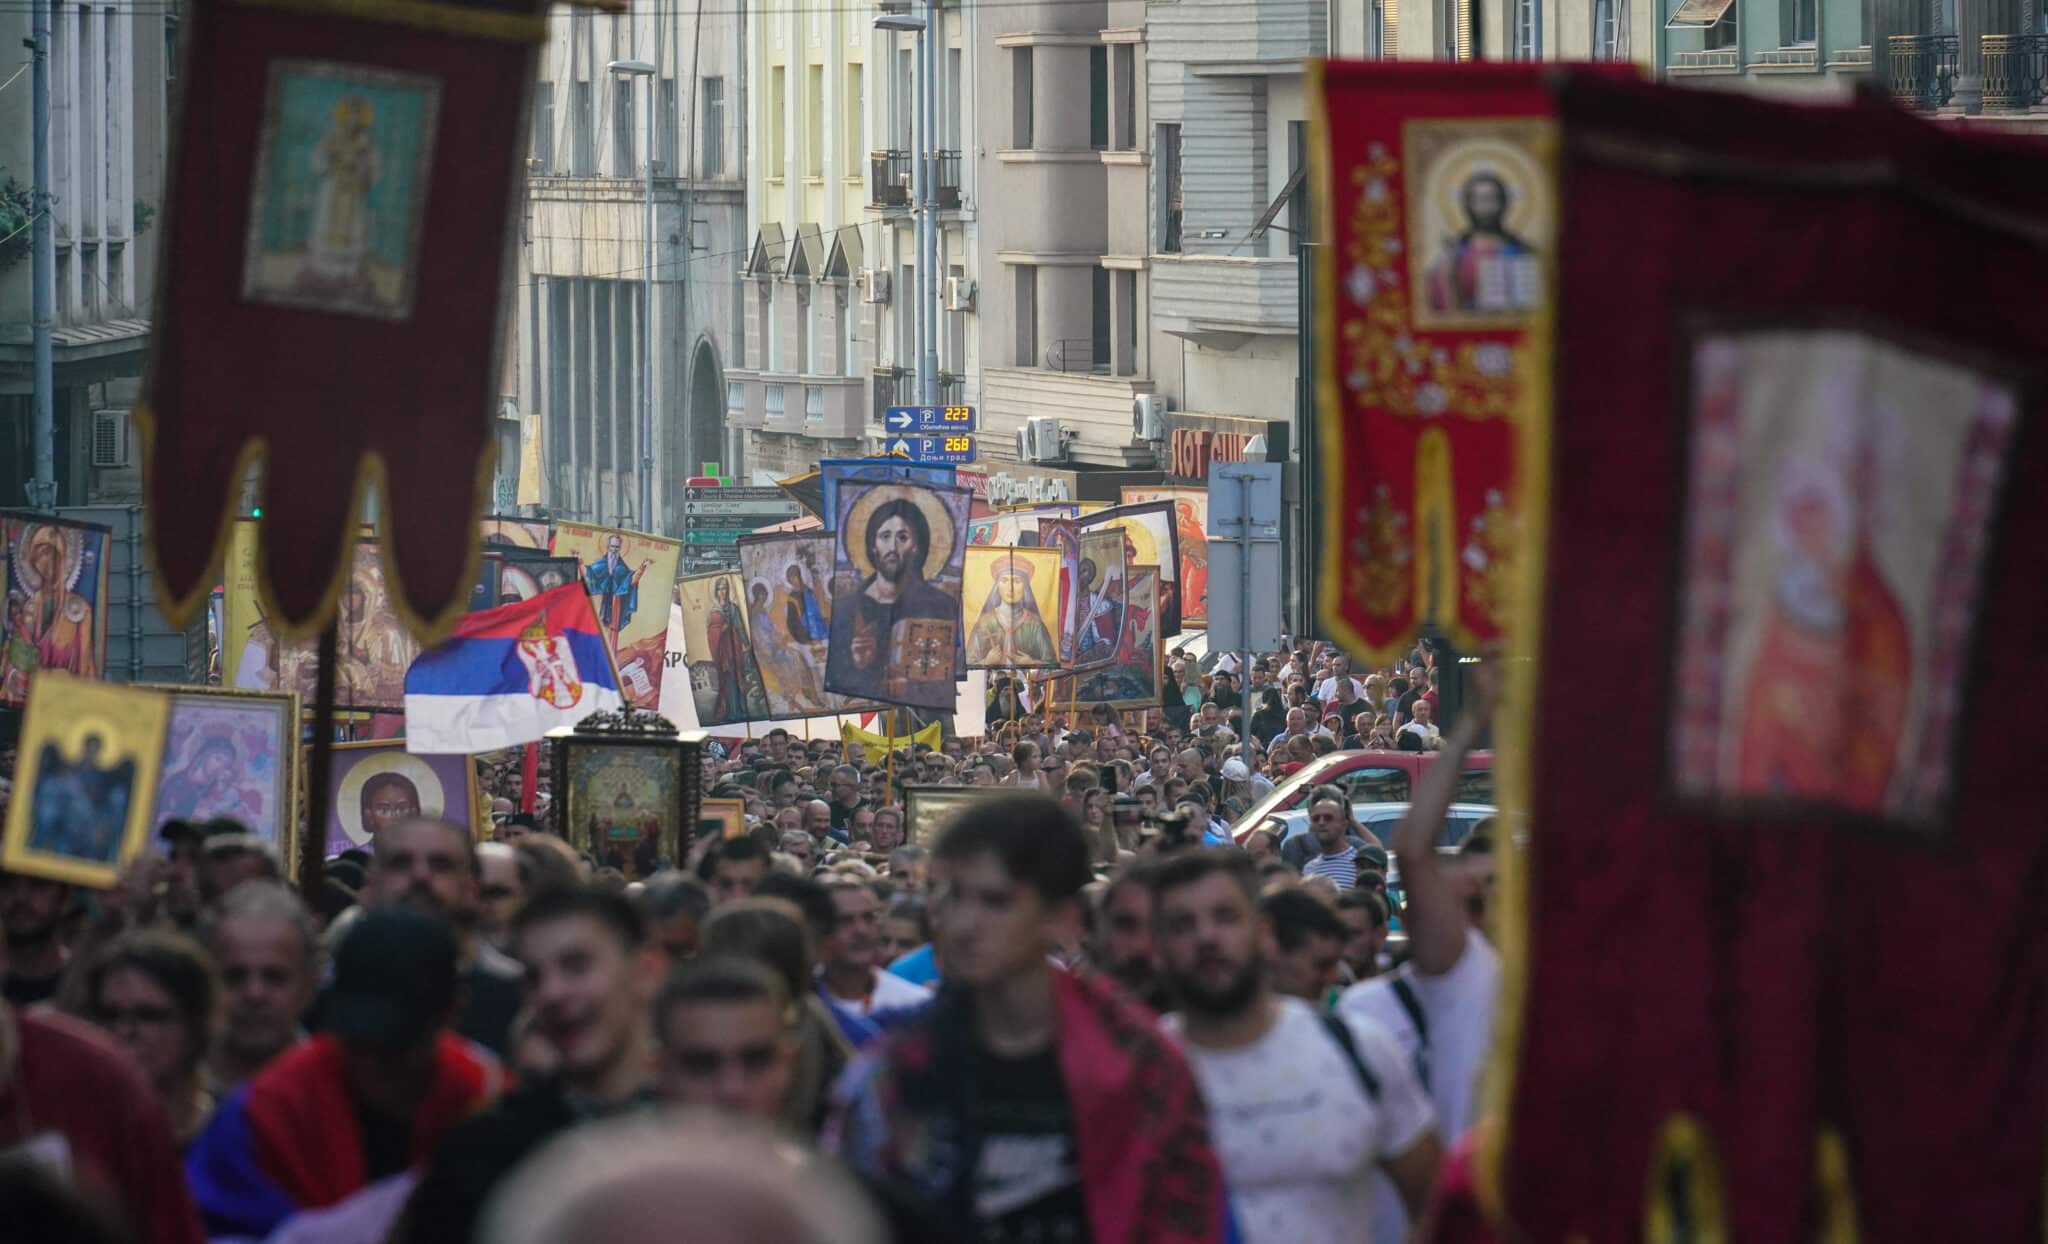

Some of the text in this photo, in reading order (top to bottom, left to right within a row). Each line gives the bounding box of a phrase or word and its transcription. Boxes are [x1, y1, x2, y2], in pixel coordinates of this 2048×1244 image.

[944, 407, 969, 421] 223
[944, 438, 969, 452] 268
[920, 454, 944, 462] Доњи
[1171, 428, 1204, 479] SLOT
